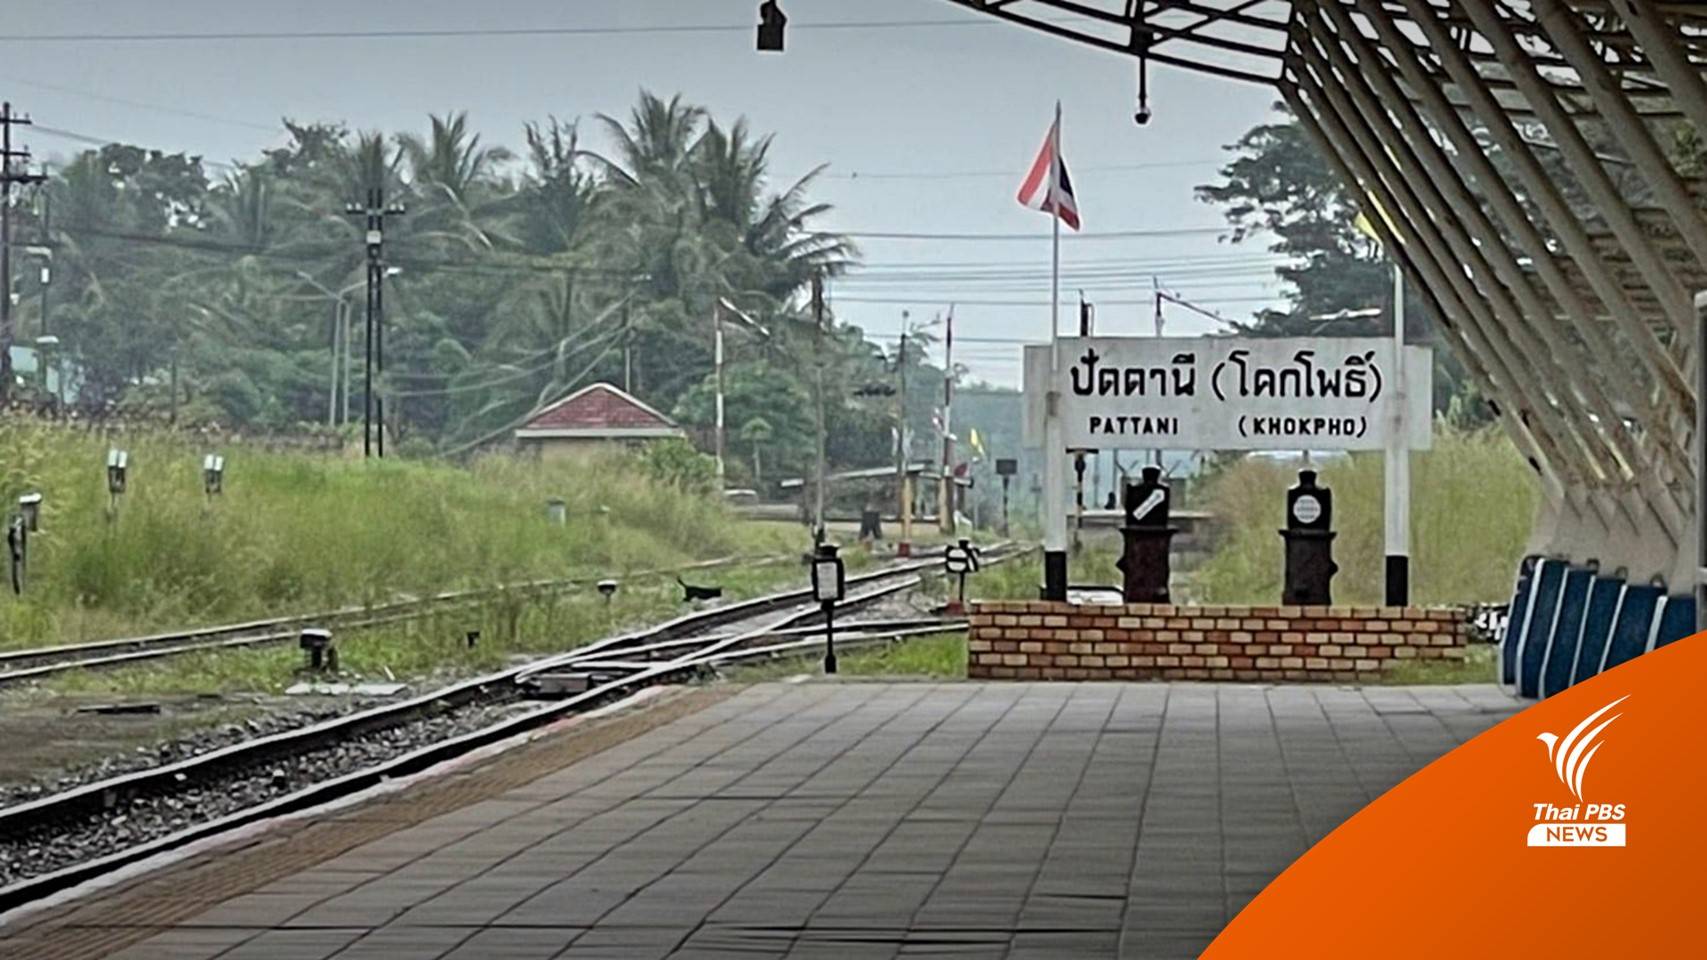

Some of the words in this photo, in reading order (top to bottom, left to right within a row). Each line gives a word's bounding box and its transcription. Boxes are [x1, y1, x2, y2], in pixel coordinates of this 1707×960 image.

[1211, 350, 1382, 403] (โคกโพธิ์)
[1089, 416, 1178, 435] PATTANI
[1238, 415, 1367, 438] (KHOKPHO)
